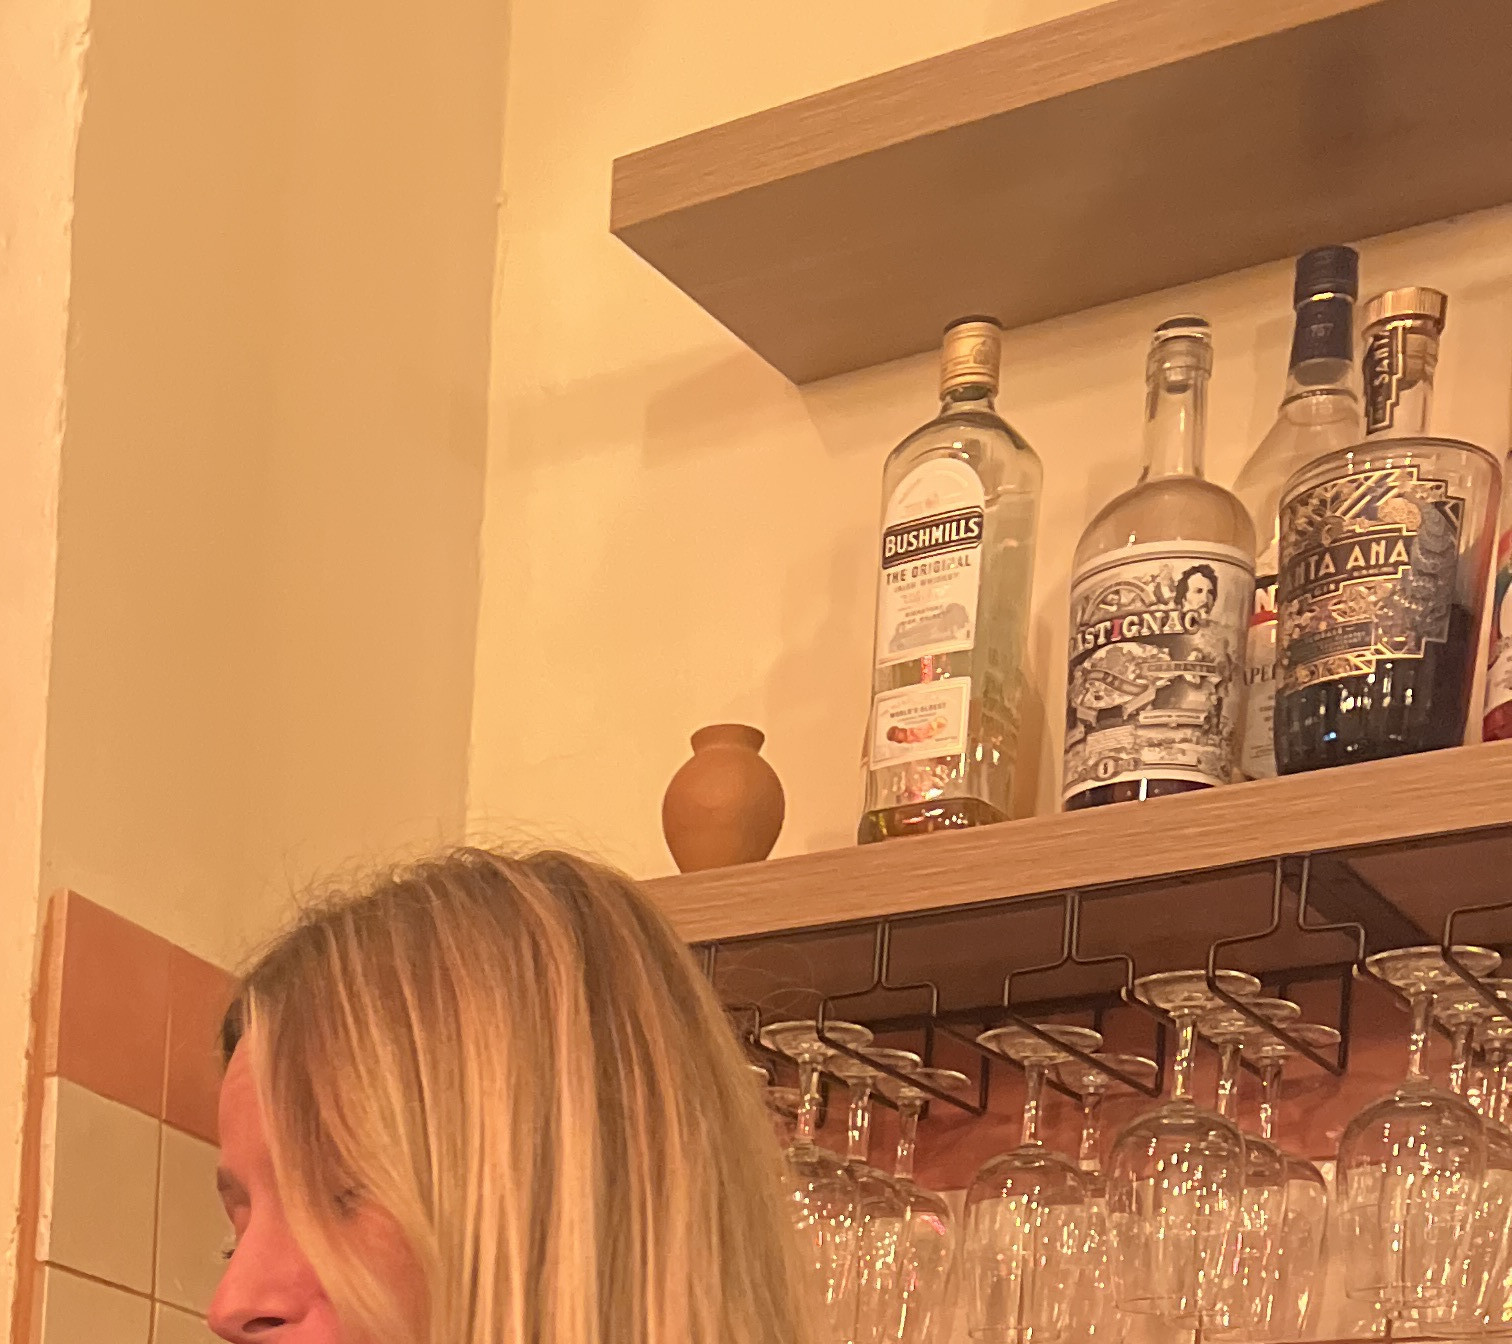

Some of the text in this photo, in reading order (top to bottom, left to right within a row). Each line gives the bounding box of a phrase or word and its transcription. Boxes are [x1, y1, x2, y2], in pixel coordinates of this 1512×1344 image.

[884, 517, 980, 558] BUSHMILLS
[1345, 538, 1410, 571] ANA
[886, 568, 907, 586] THE
[1070, 610, 1200, 651] ASTIGNAC
